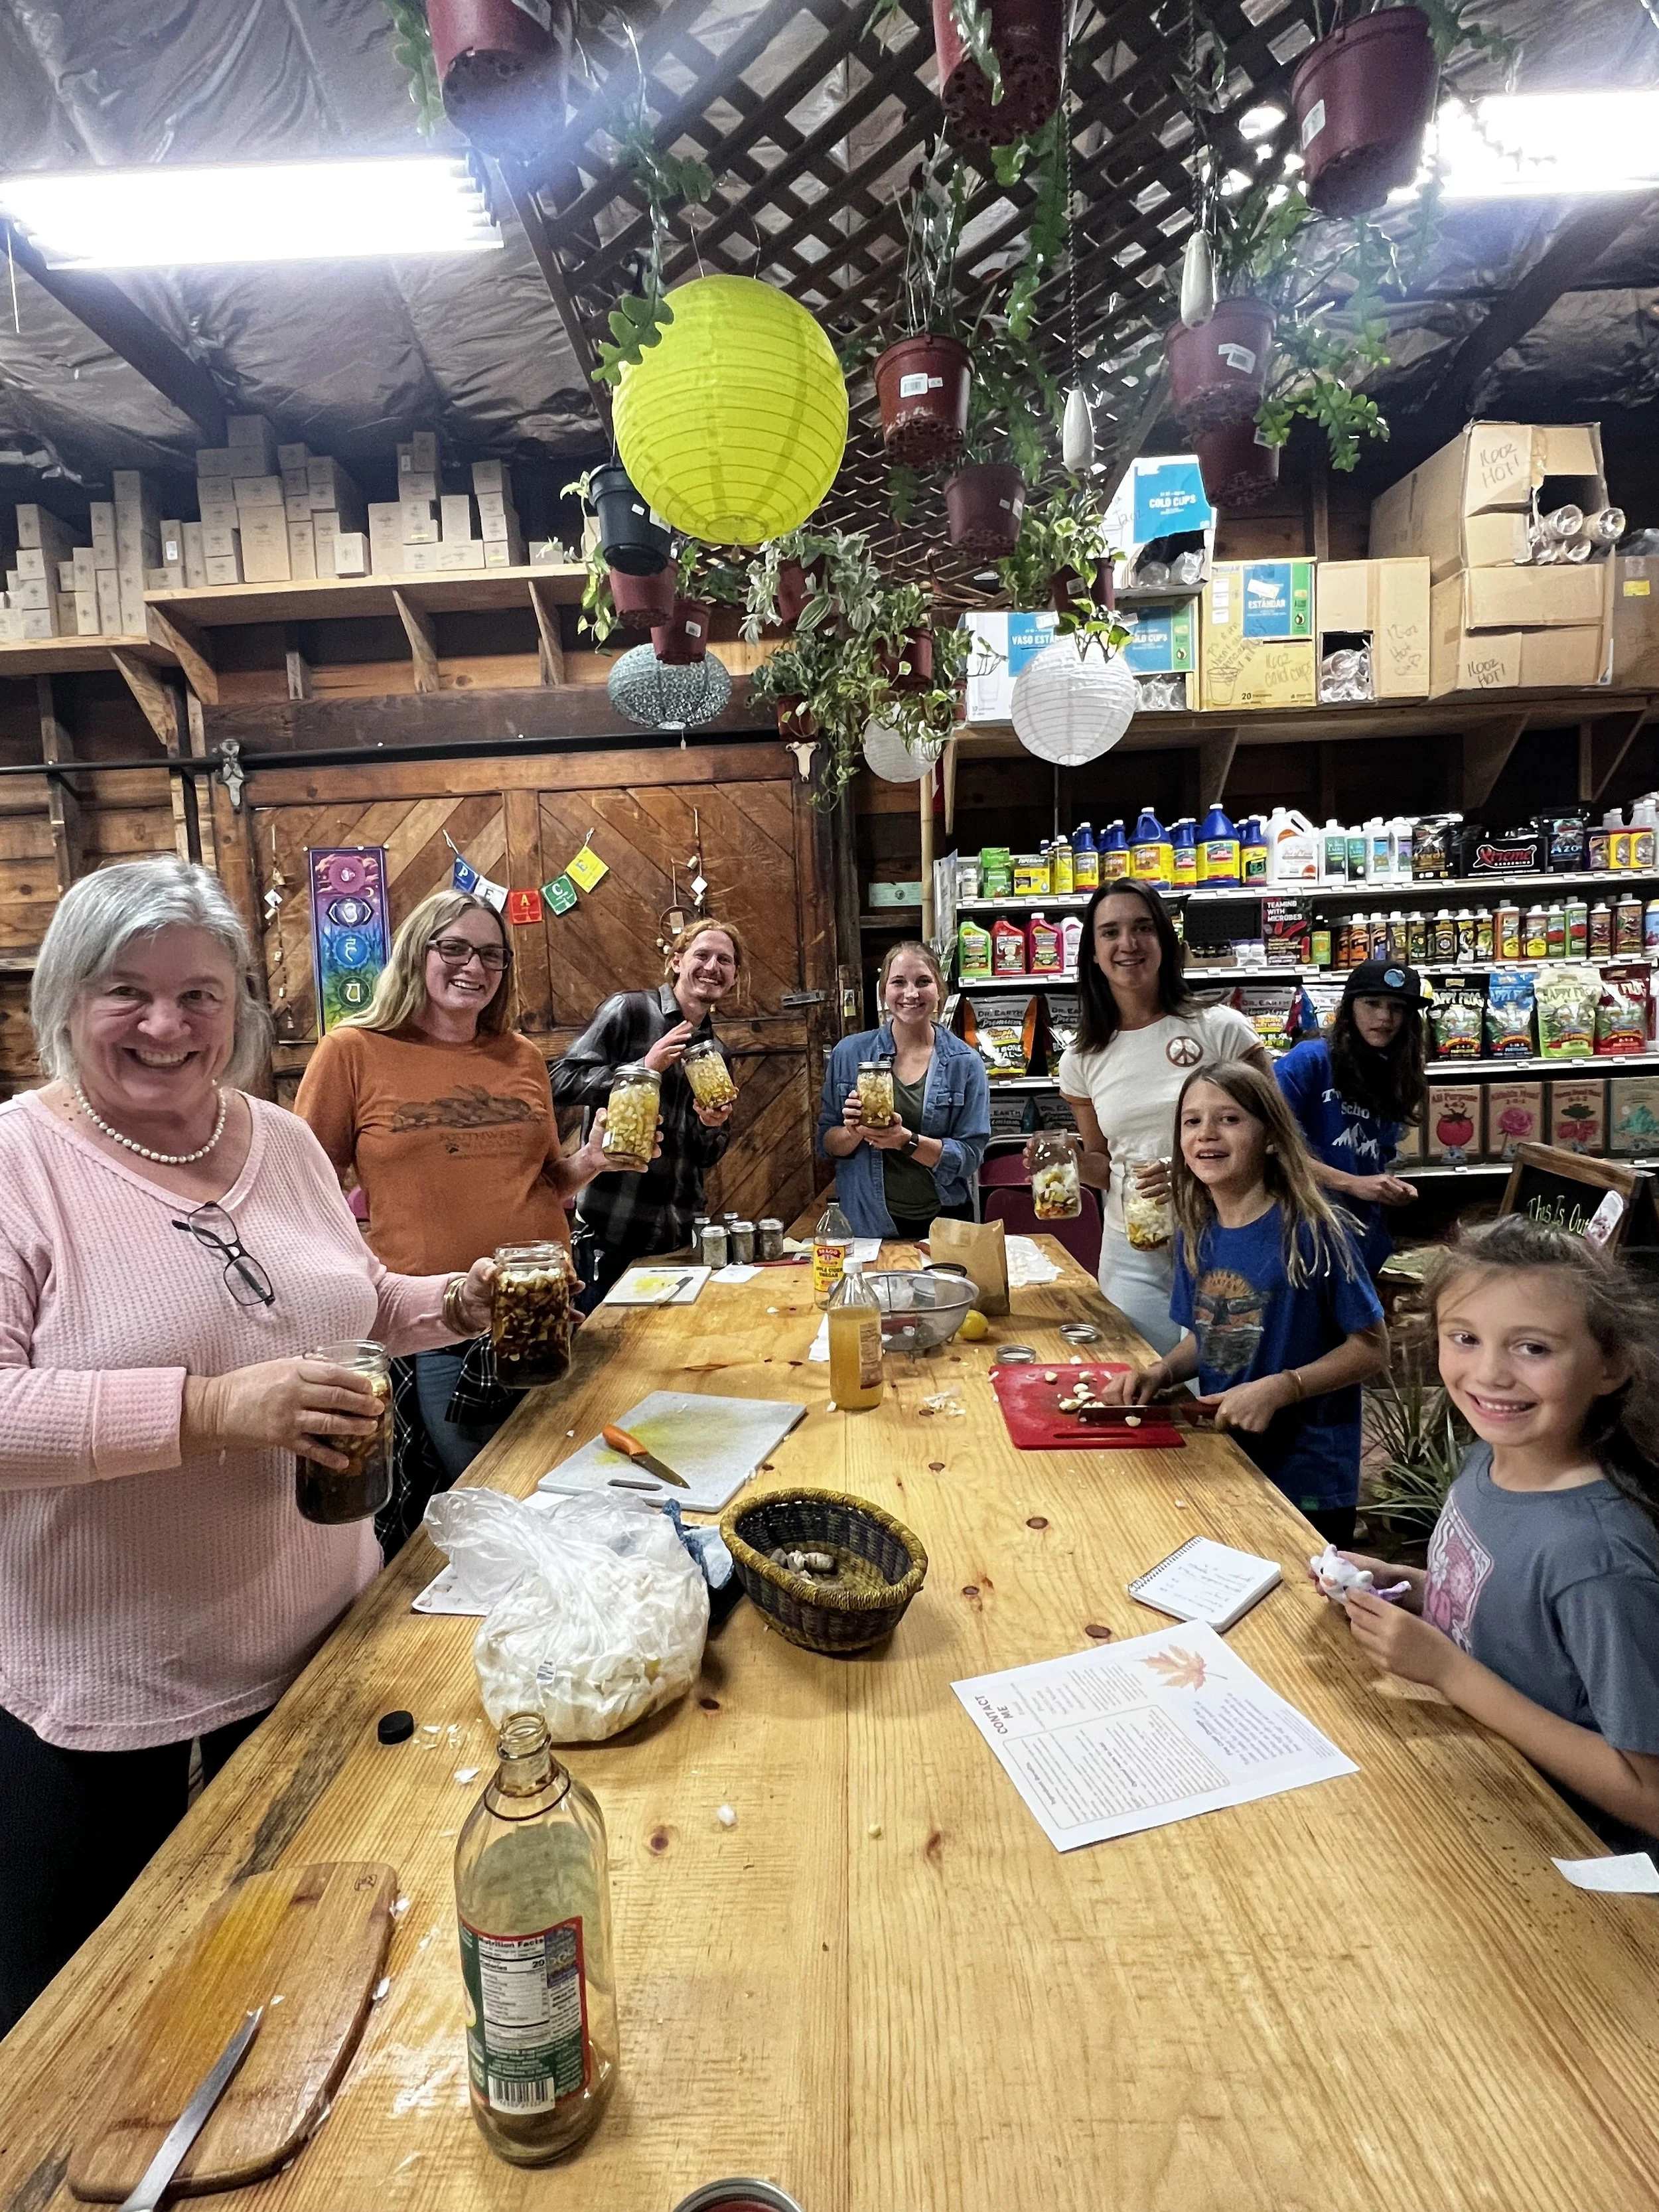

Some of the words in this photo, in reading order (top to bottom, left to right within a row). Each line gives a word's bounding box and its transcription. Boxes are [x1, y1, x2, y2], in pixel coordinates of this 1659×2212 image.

[1149, 498, 1172, 509] COLD
[1173, 494, 1196, 507] CUPS
[1011, 635, 1033, 645] VASO
[1148, 633, 1168, 642] CUPS
[1267, 914, 1303, 922] MICROBES
[1527, 1195, 1551, 1224] This
[974, 1695, 1009, 1734] CONTACT
[996, 1704, 1014, 1719] ME
[479, 1937, 515, 1949] Nutrition
[518, 1938, 544, 1948] Facts
[532, 1959, 545, 1969] 20
